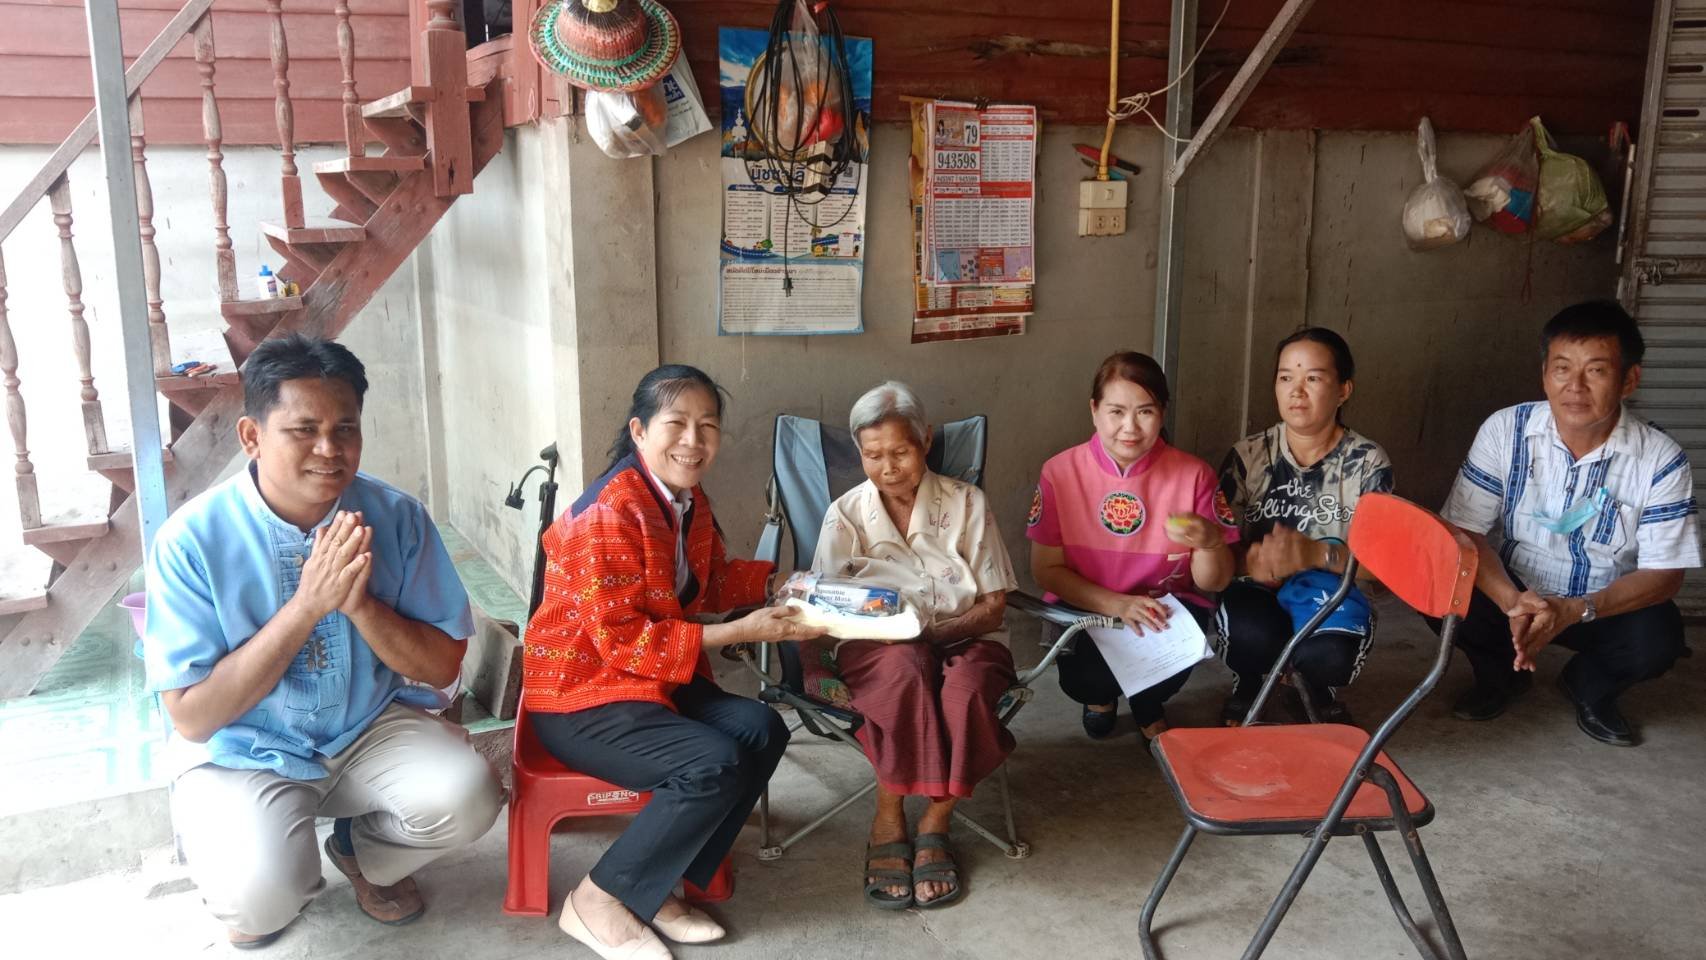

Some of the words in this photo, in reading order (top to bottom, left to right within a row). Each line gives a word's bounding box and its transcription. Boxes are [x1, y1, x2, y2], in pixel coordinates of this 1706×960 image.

[965, 125, 978, 144] 79
[937, 152, 977, 169] 943598
[1275, 478, 1314, 499] the
